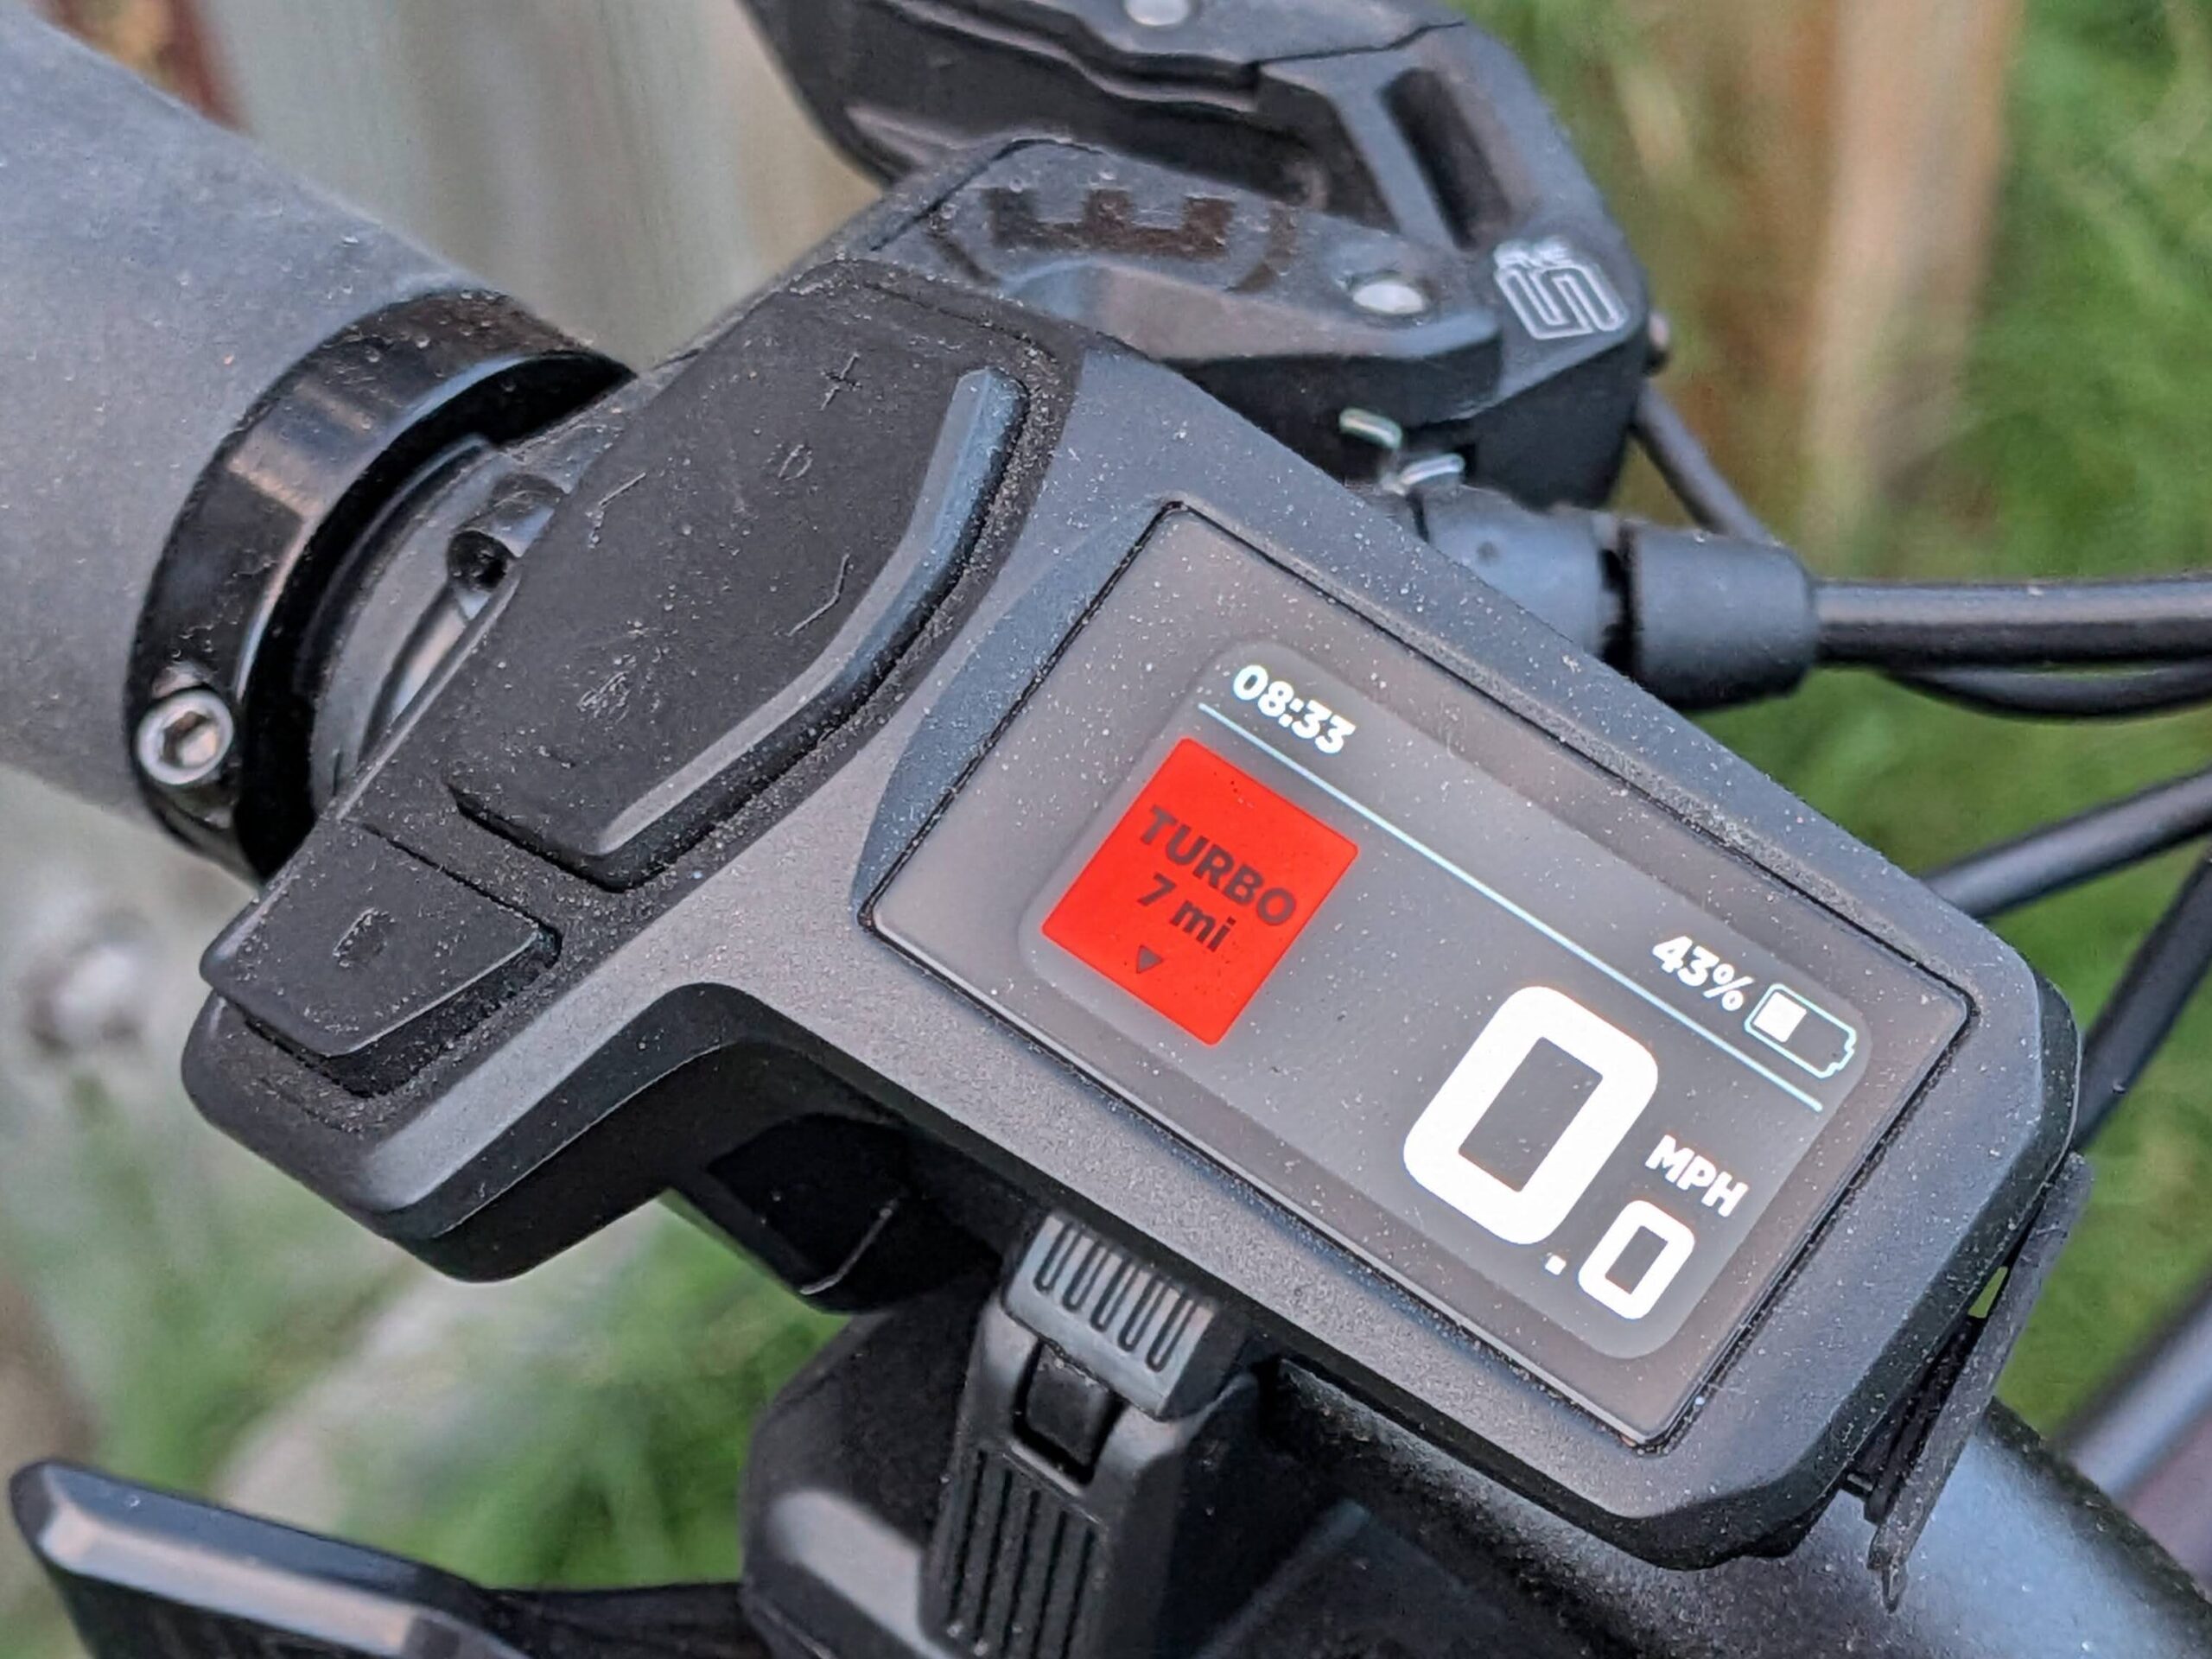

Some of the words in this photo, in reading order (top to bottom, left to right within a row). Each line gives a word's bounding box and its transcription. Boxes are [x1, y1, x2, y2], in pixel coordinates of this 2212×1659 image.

[1232, 664, 1356, 753] 08:33
[1139, 804, 1296, 925] TURBO
[1137, 874, 1177, 906] 7
[1170, 900, 1236, 951] mi
[1651, 935, 1753, 1012] 43%
[1644, 1134, 1749, 1217] MPH
